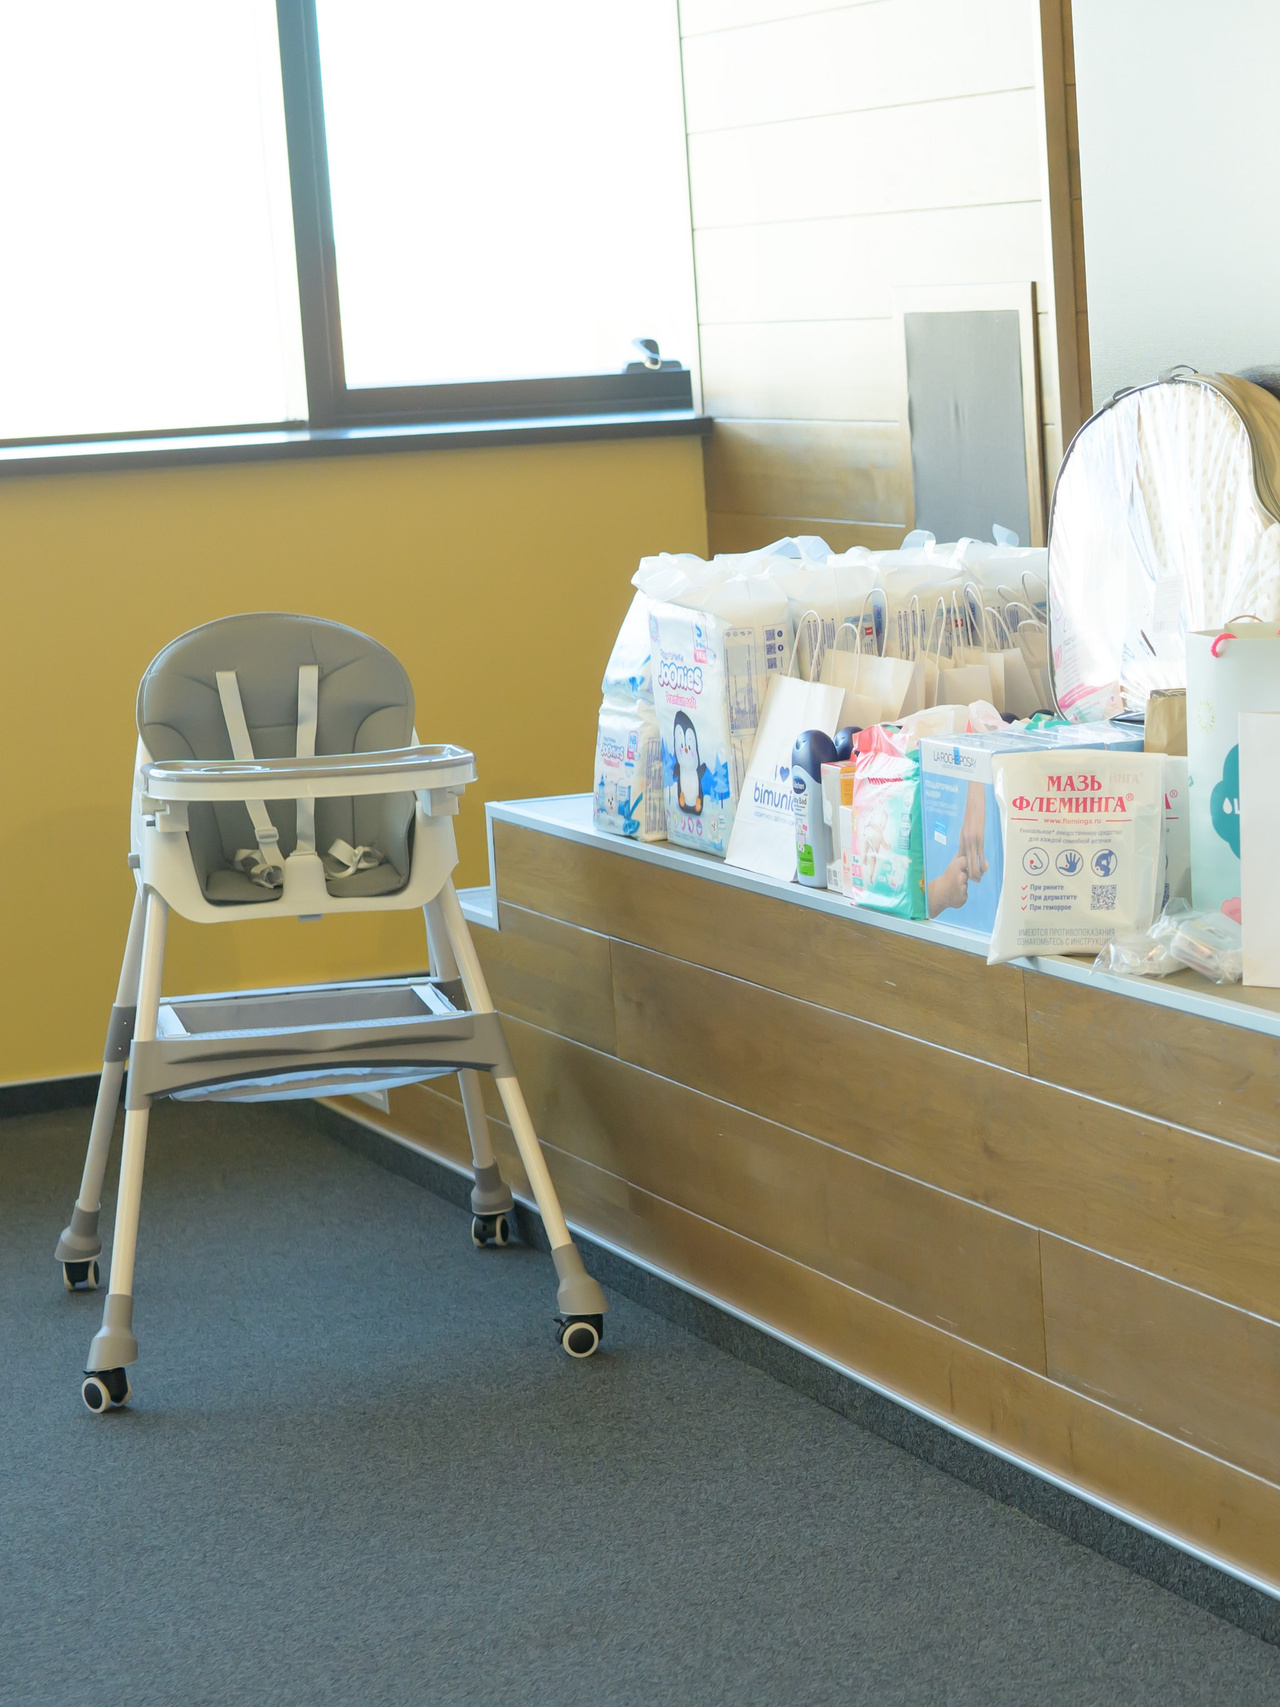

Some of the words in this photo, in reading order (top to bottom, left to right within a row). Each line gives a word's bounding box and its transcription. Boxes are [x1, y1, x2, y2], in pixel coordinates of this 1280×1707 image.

[1047, 775, 1102, 792] МАЗЬ
[1044, 817, 1102, 826] www.fleminga.ru
[1040, 836, 1062, 844] каждой
[1044, 884, 1064, 892] рините
[1043, 894, 1077, 902] дерматите
[1018, 928, 1048, 936] ИМЕЮТСЯ
[1049, 928, 1115, 936] ПРОТИВОПОКАЗАНИЯ
[1017, 938, 1064, 946] ОЗНАКОМЬТЕСЬ
